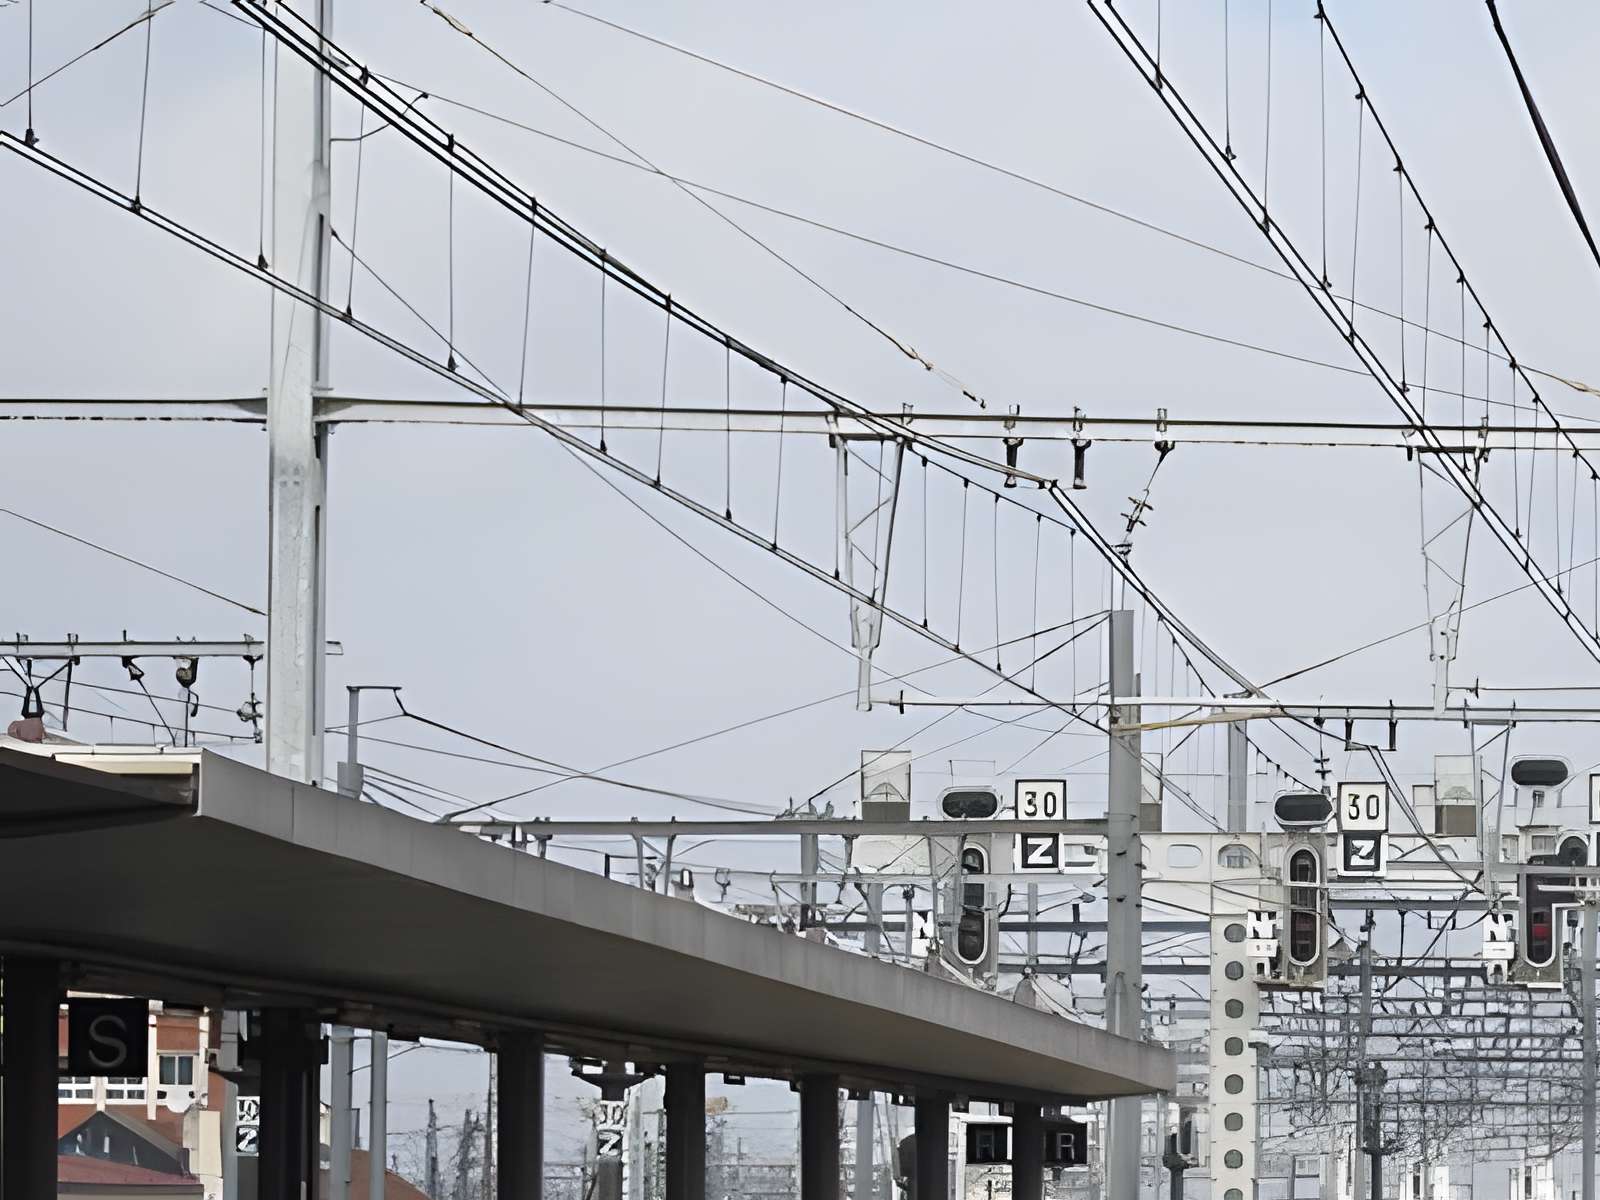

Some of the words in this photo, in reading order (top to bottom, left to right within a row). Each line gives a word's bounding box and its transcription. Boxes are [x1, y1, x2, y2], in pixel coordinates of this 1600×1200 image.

[1023, 790, 1058, 818] 30
[1347, 793, 1380, 820] 30
[1026, 837, 1054, 865] Z
[1350, 839, 1376, 866] Z
[87, 1013, 129, 1070] S
